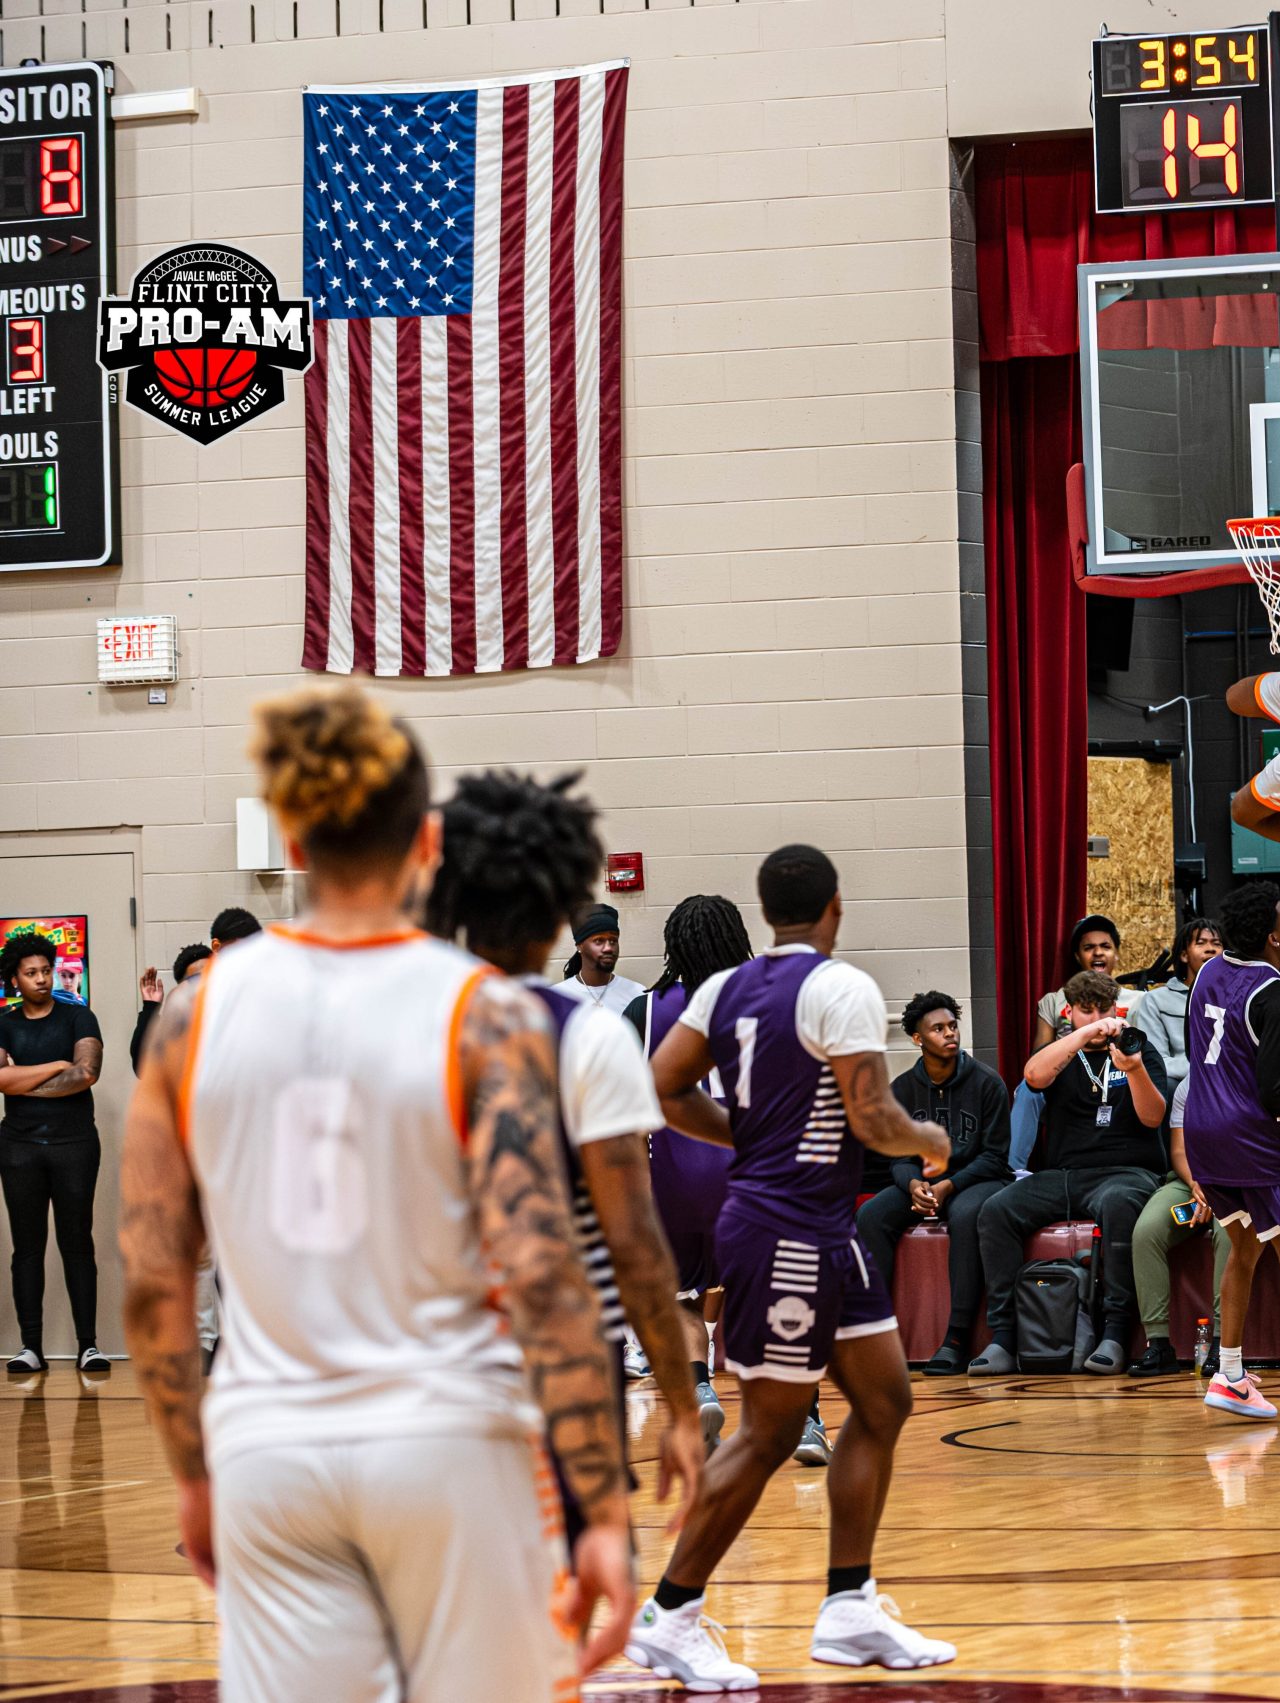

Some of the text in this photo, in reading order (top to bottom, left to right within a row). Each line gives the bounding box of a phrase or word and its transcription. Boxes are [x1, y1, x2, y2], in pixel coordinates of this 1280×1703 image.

[1138, 34, 1255, 89] 3:54
[0, 82, 92, 124] SITOR
[40, 138, 81, 214] 8
[1162, 104, 1238, 199] 14
[10, 320, 42, 381] 3
[0, 386, 55, 416] LEFT
[0, 431, 59, 460] OULS
[44, 466, 56, 525] 1
[1151, 536, 1211, 547] GARED
[113, 624, 157, 662] EXIT
[734, 1016, 759, 1109] 1
[1203, 1003, 1227, 1065] 7
